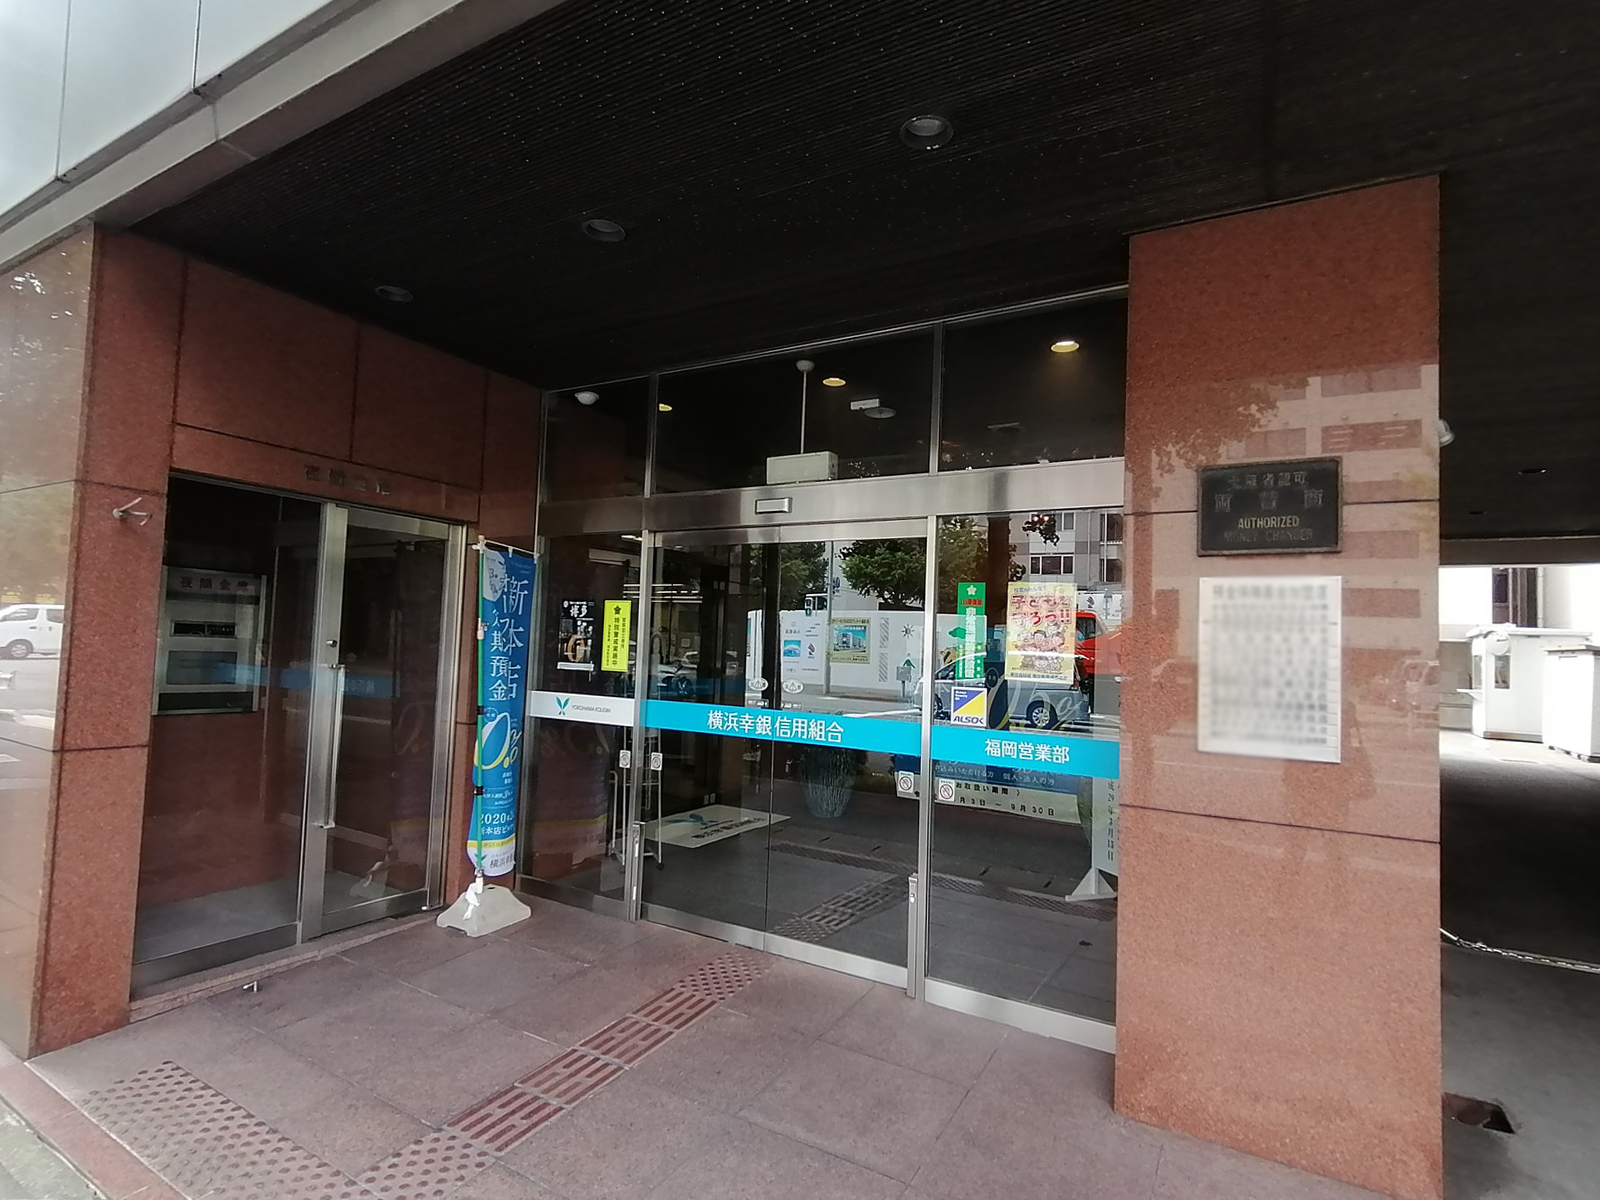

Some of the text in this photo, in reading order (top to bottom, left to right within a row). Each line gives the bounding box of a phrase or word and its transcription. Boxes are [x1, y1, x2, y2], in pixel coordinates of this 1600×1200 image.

[1238, 515, 1300, 529] AUTHORIZED
[707, 710, 844, 743] 横浜幸銀信用組合
[953, 715, 984, 725] ALSOK
[984, 739, 1071, 764] 福岡営業部
